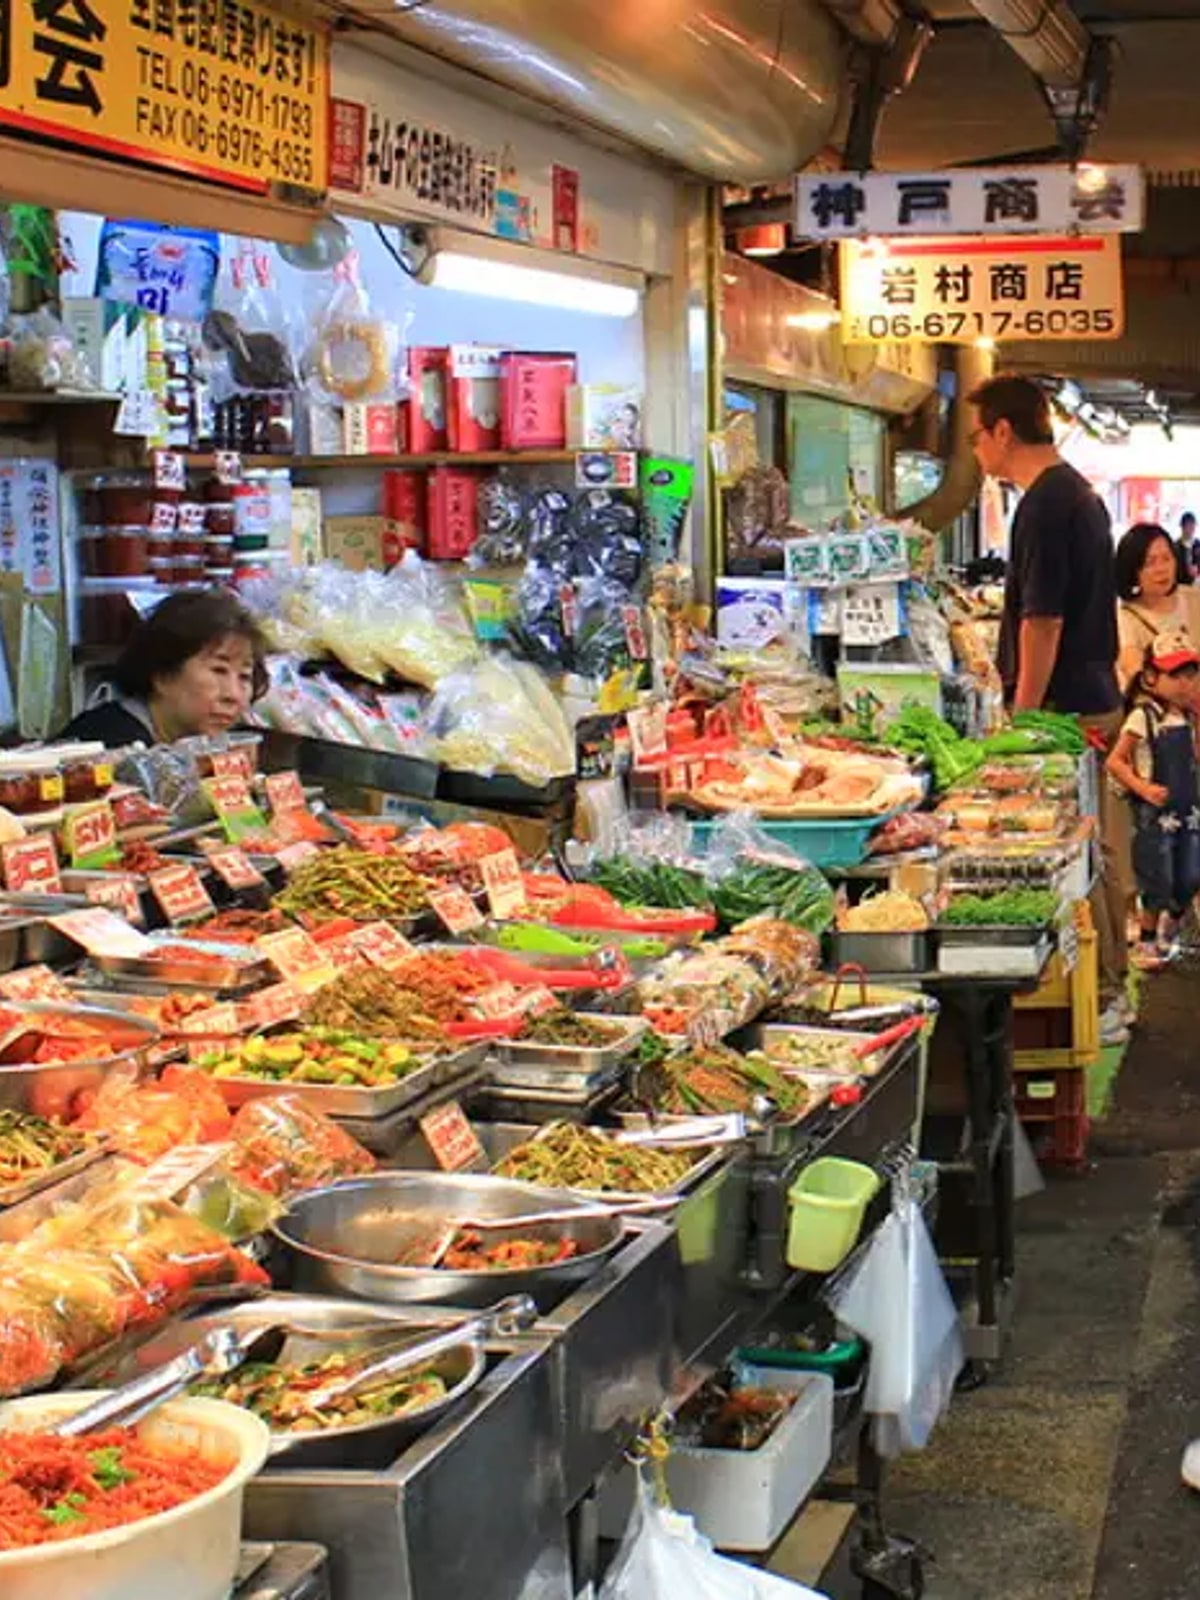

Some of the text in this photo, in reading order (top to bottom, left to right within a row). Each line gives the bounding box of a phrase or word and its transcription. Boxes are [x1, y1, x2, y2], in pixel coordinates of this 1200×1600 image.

[0, 0, 107, 117] 会
[136, 46, 312, 139] TEL 06-6971-1793
[136, 98, 178, 142] FAX
[181, 110, 313, 182] 06-6976-4355
[810, 177, 1127, 227] 神戸商会
[881, 261, 1083, 304] 岩村商店
[868, 309, 1114, 339] 06-6717-6035
